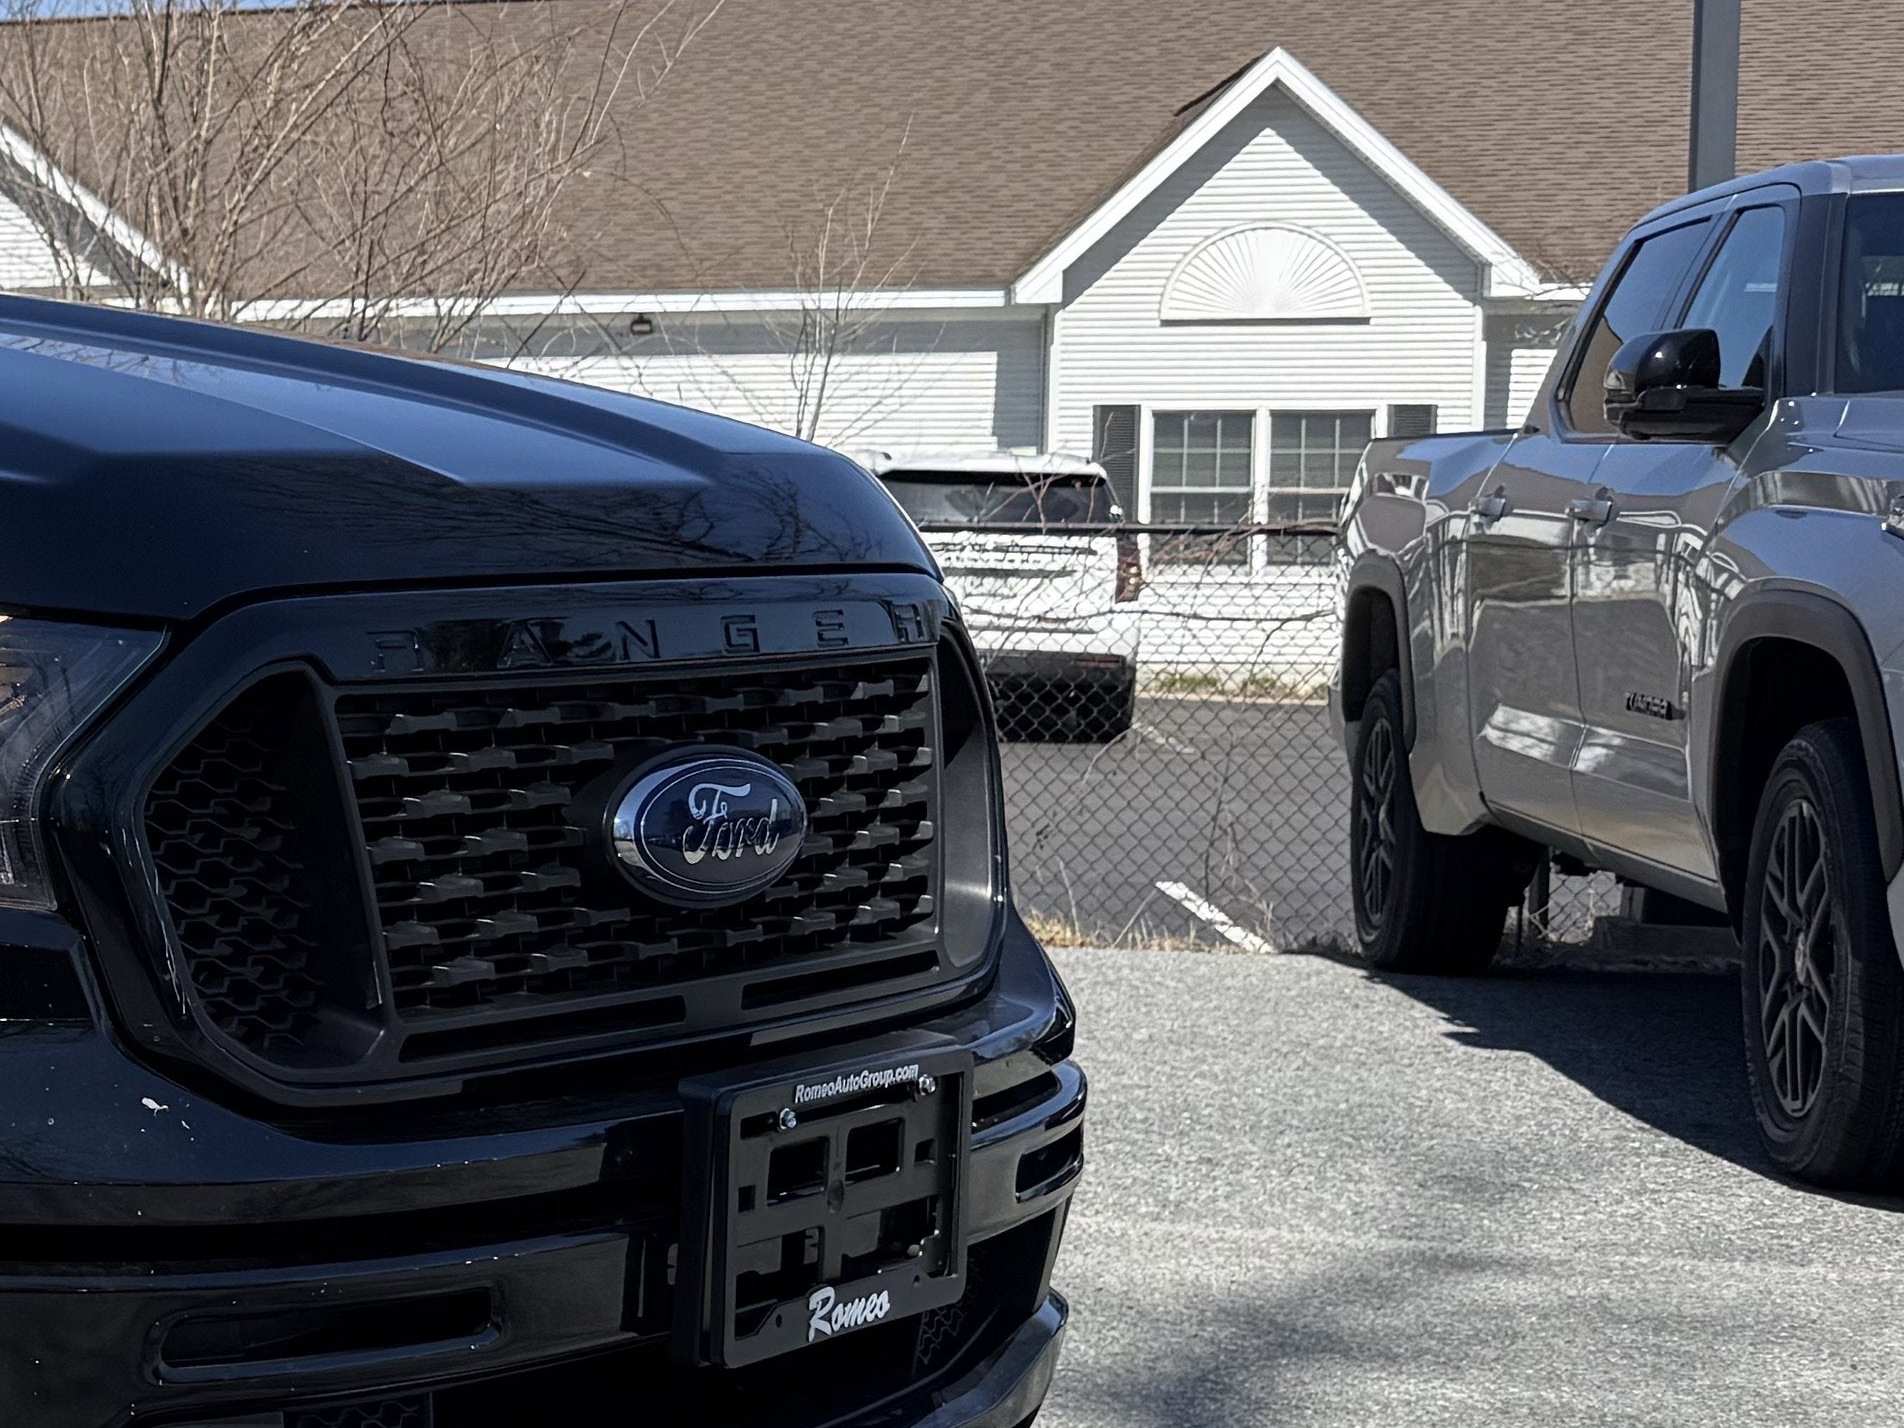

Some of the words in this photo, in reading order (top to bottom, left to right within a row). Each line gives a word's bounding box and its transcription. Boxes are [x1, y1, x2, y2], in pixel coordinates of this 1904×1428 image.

[368, 604, 925, 672] RANGER
[683, 783, 780, 865] Ford
[794, 1064, 919, 1104] RomeoAutoGroup.com
[808, 1286, 891, 1343] Romeo
